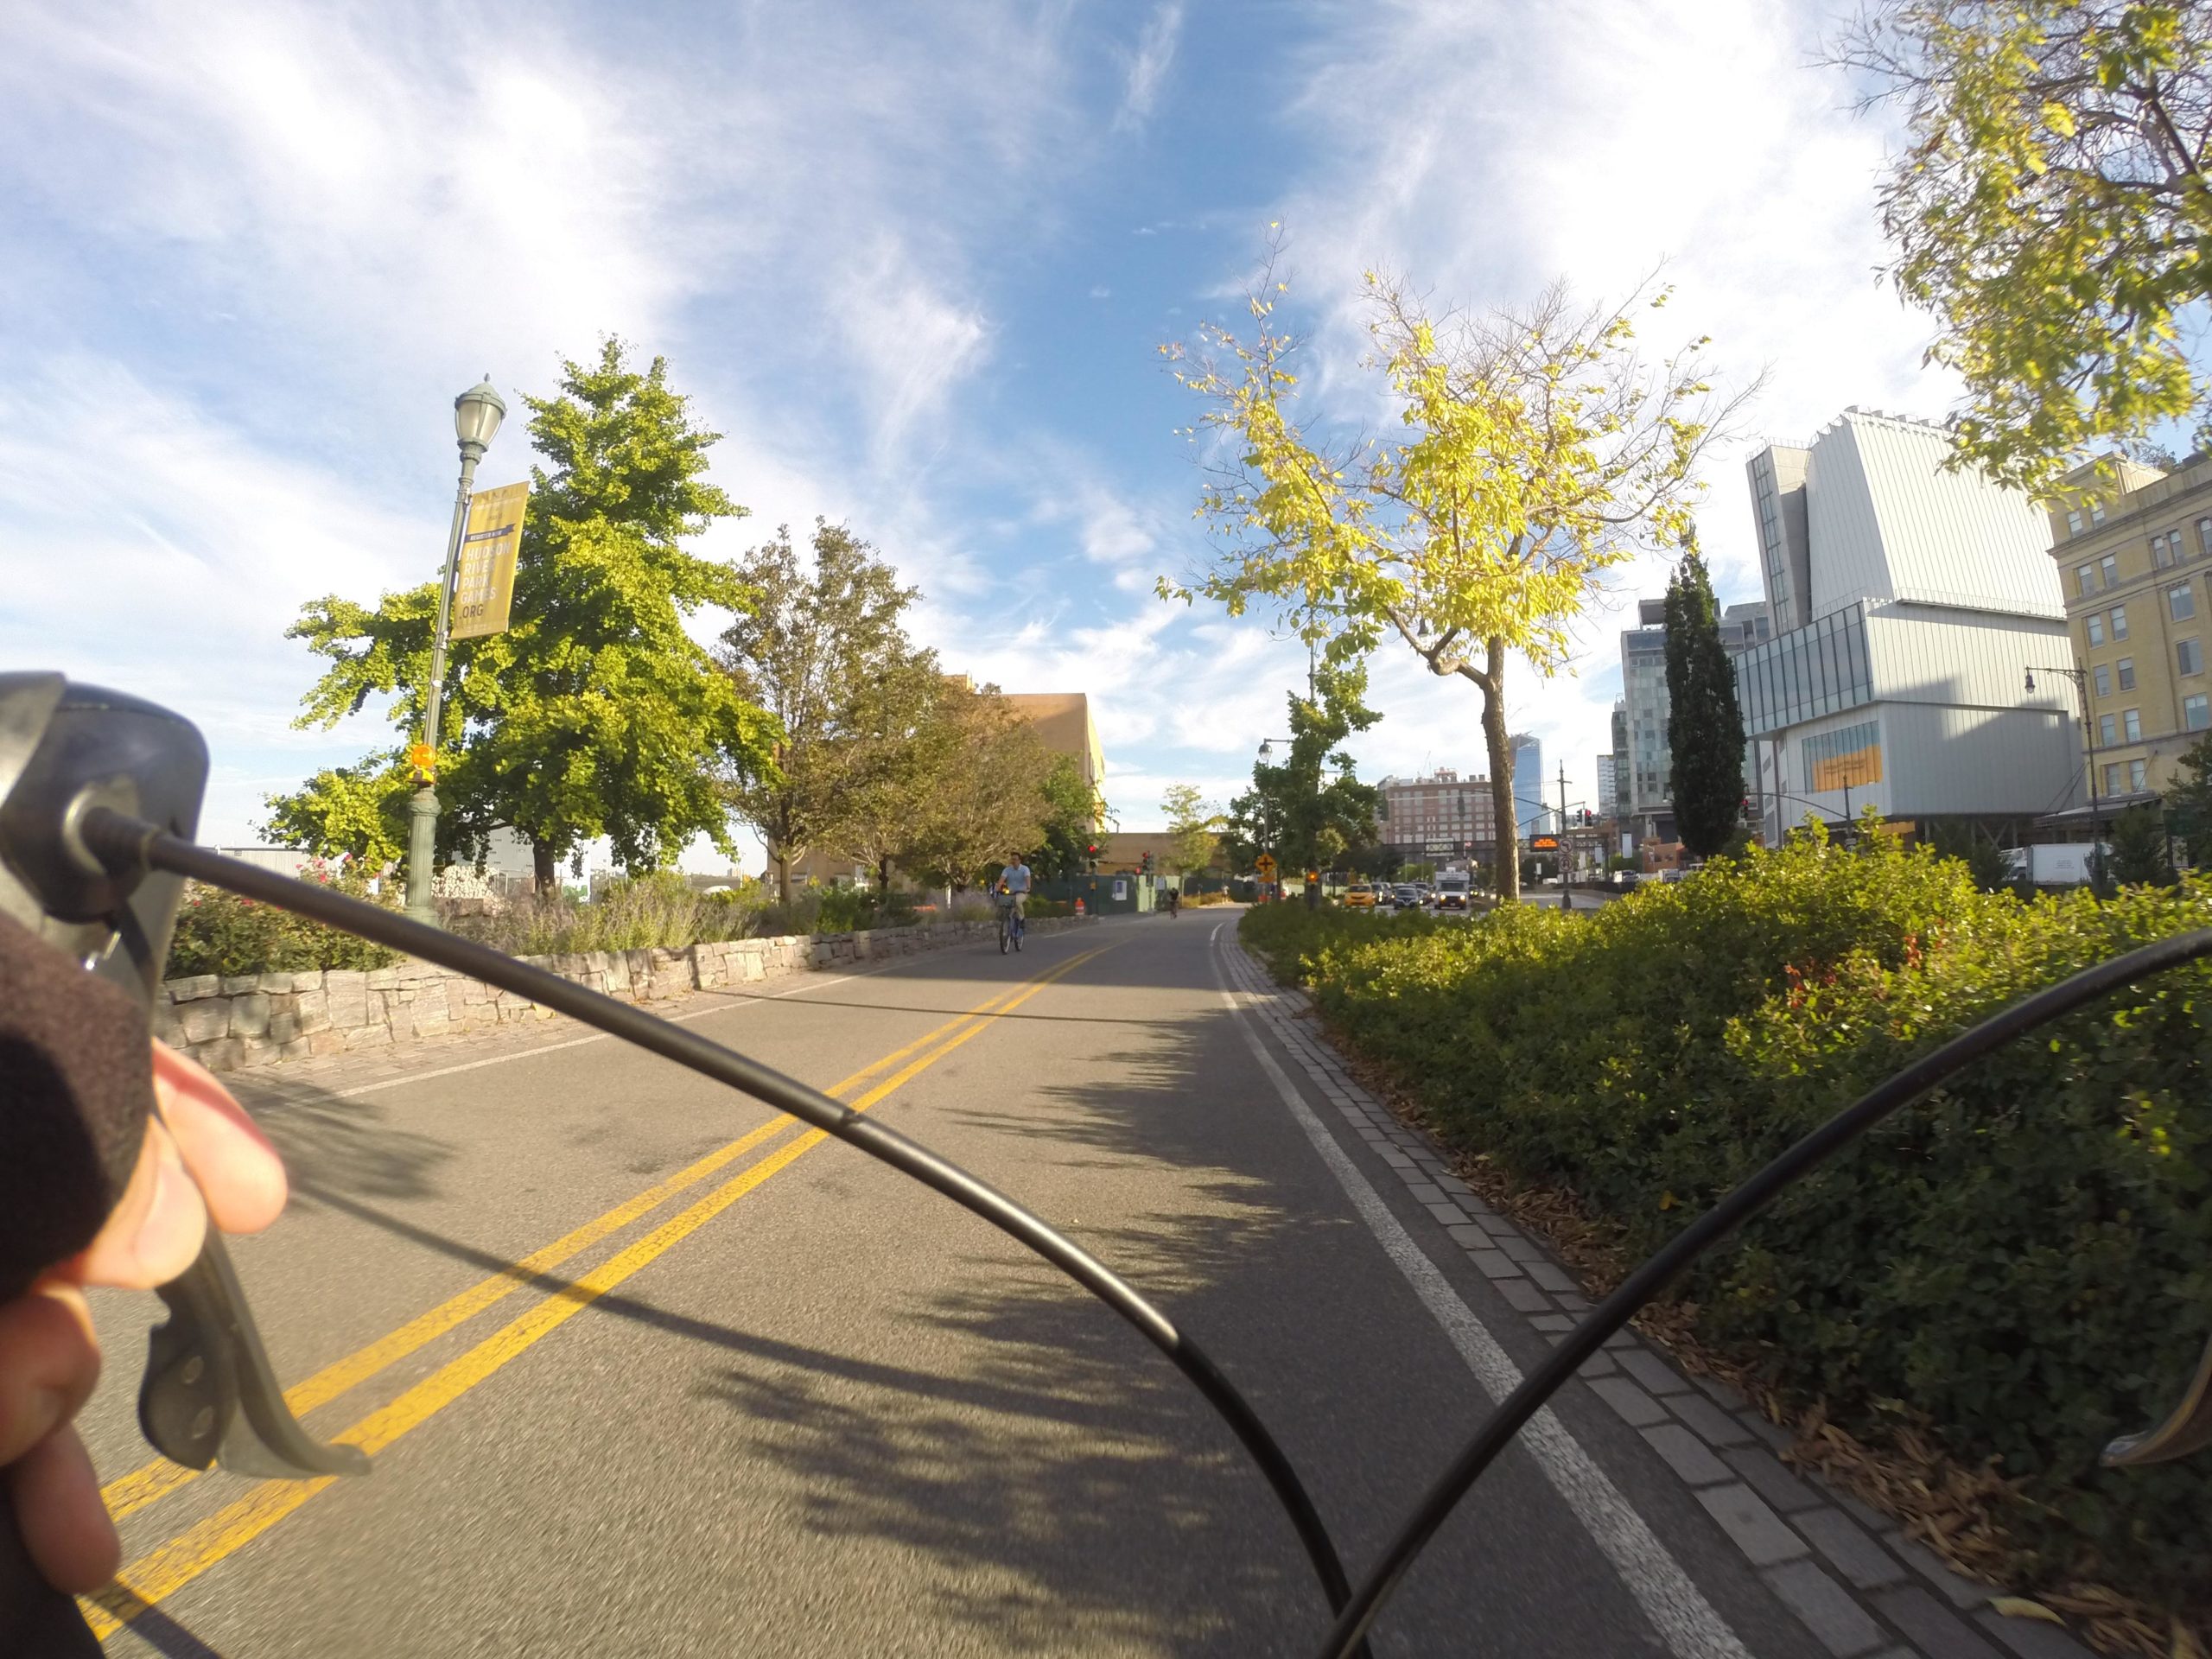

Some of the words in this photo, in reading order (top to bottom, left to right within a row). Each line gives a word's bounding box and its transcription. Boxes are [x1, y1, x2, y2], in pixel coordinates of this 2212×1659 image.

[467, 542, 511, 560] HUDSON
[464, 560, 494, 575] RIVER
[462, 574, 490, 589] PARK
[461, 588, 497, 604] GAMES
[459, 604, 484, 619] .ORG
